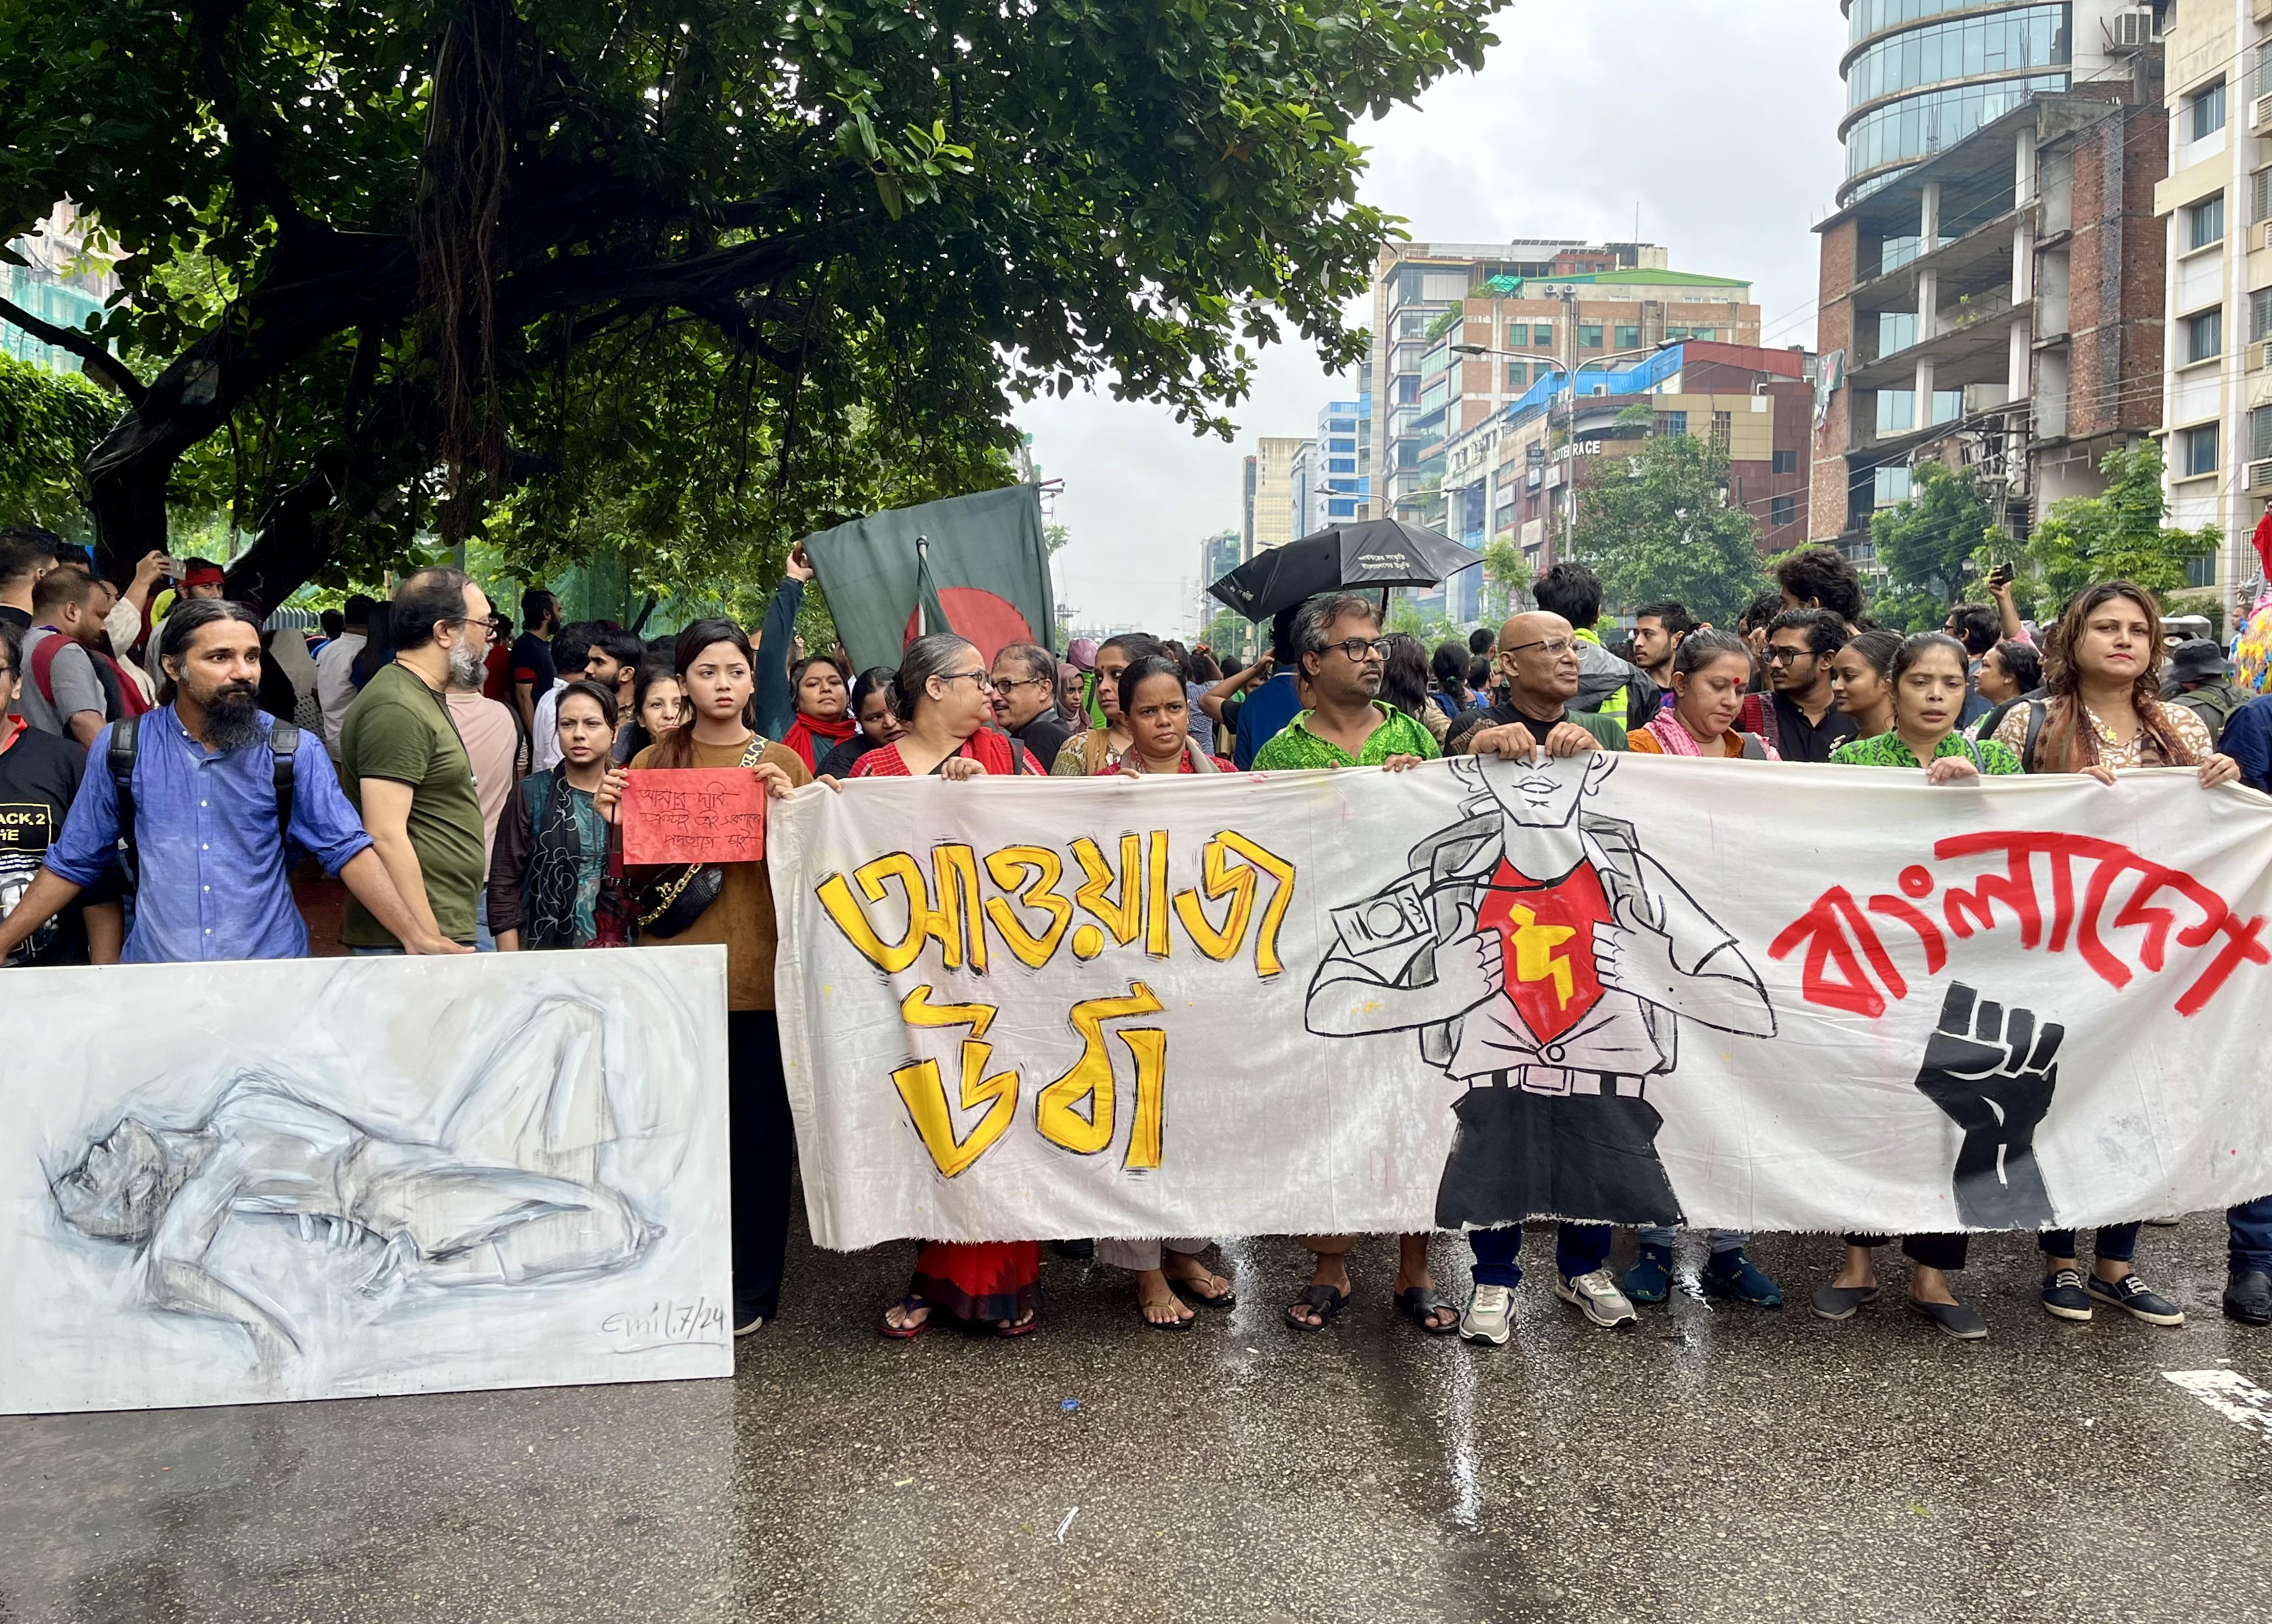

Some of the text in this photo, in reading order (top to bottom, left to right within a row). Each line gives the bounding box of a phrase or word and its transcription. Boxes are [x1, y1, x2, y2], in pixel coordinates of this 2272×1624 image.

[636, 781, 739, 810] আমার দাবি
[36, 813, 46, 825] 2
[694, 809, 719, 830] এই
[725, 829, 763, 852] চাই
[815, 829, 1297, 978] আওয়াজ
[1767, 831, 2272, 1019] বাংলাদেশ
[889, 981, 1168, 1180] উঠা
